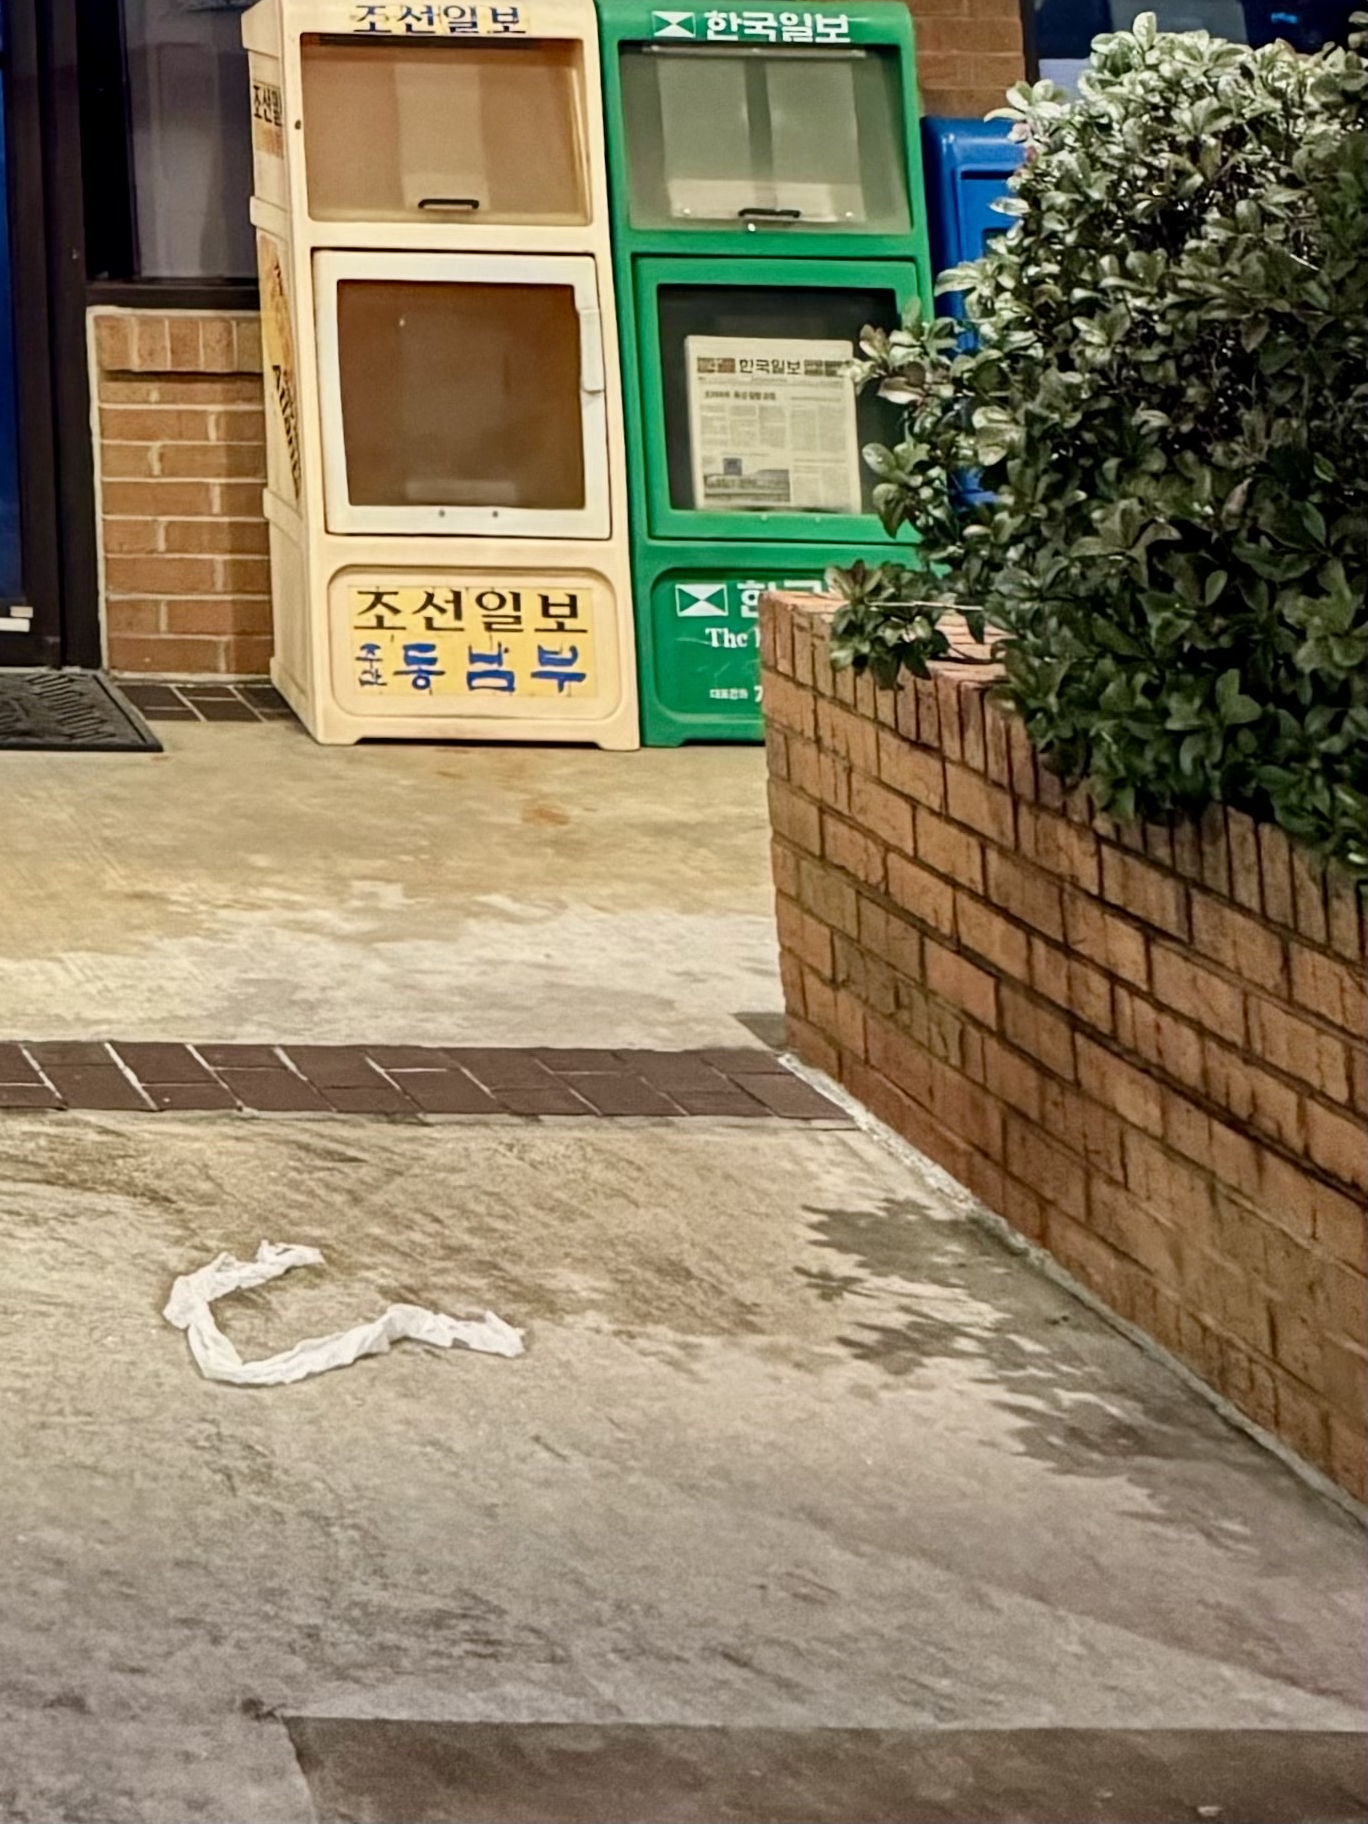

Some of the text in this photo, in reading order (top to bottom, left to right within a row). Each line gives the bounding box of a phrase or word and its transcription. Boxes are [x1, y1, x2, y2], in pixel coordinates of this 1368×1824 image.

[353, 4, 527, 35] 조선일보
[703, 10, 851, 43] 한국일보
[353, 589, 588, 633] 조선일보
[705, 627, 749, 649] The
